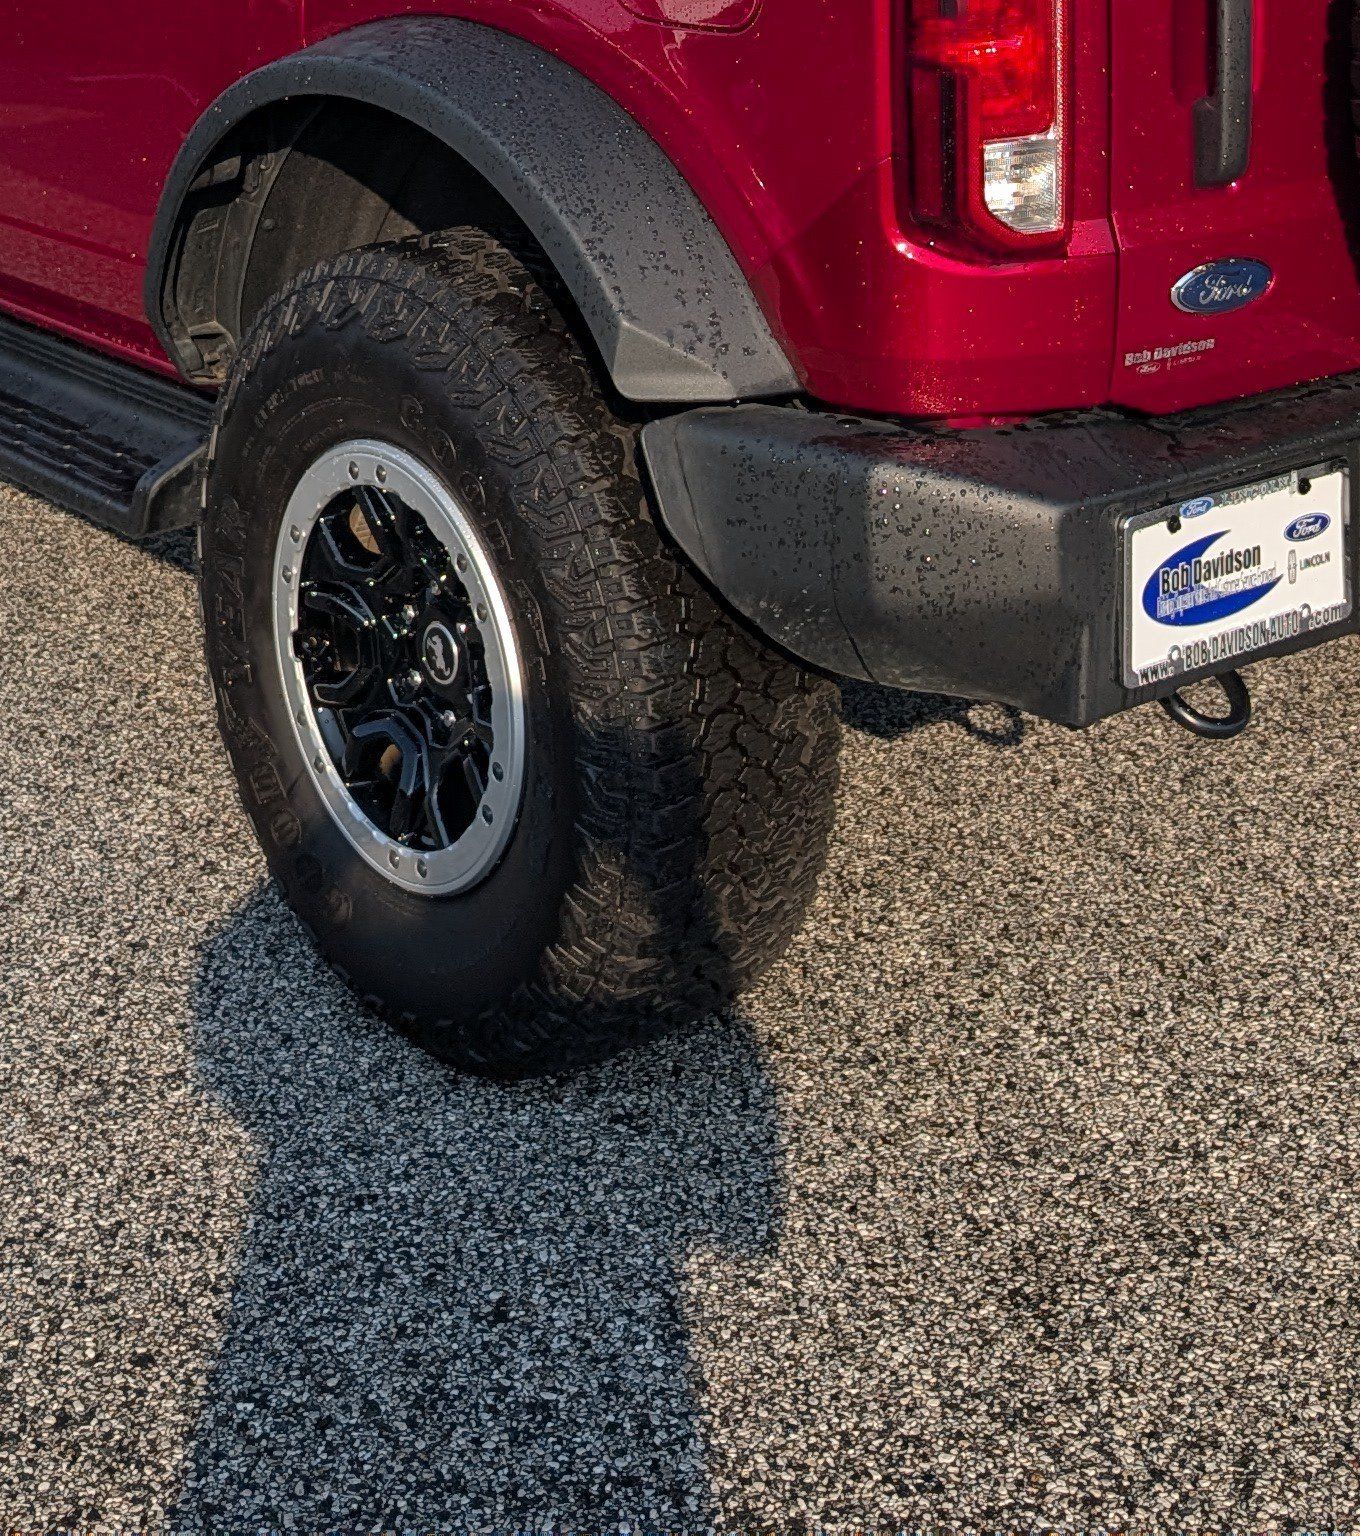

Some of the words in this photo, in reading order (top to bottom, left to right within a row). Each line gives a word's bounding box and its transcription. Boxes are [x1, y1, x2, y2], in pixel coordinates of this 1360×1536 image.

[1160, 562, 1191, 595] Bob
[1192, 544, 1262, 590] Davidson
[1299, 551, 1331, 571] LINCOLN
